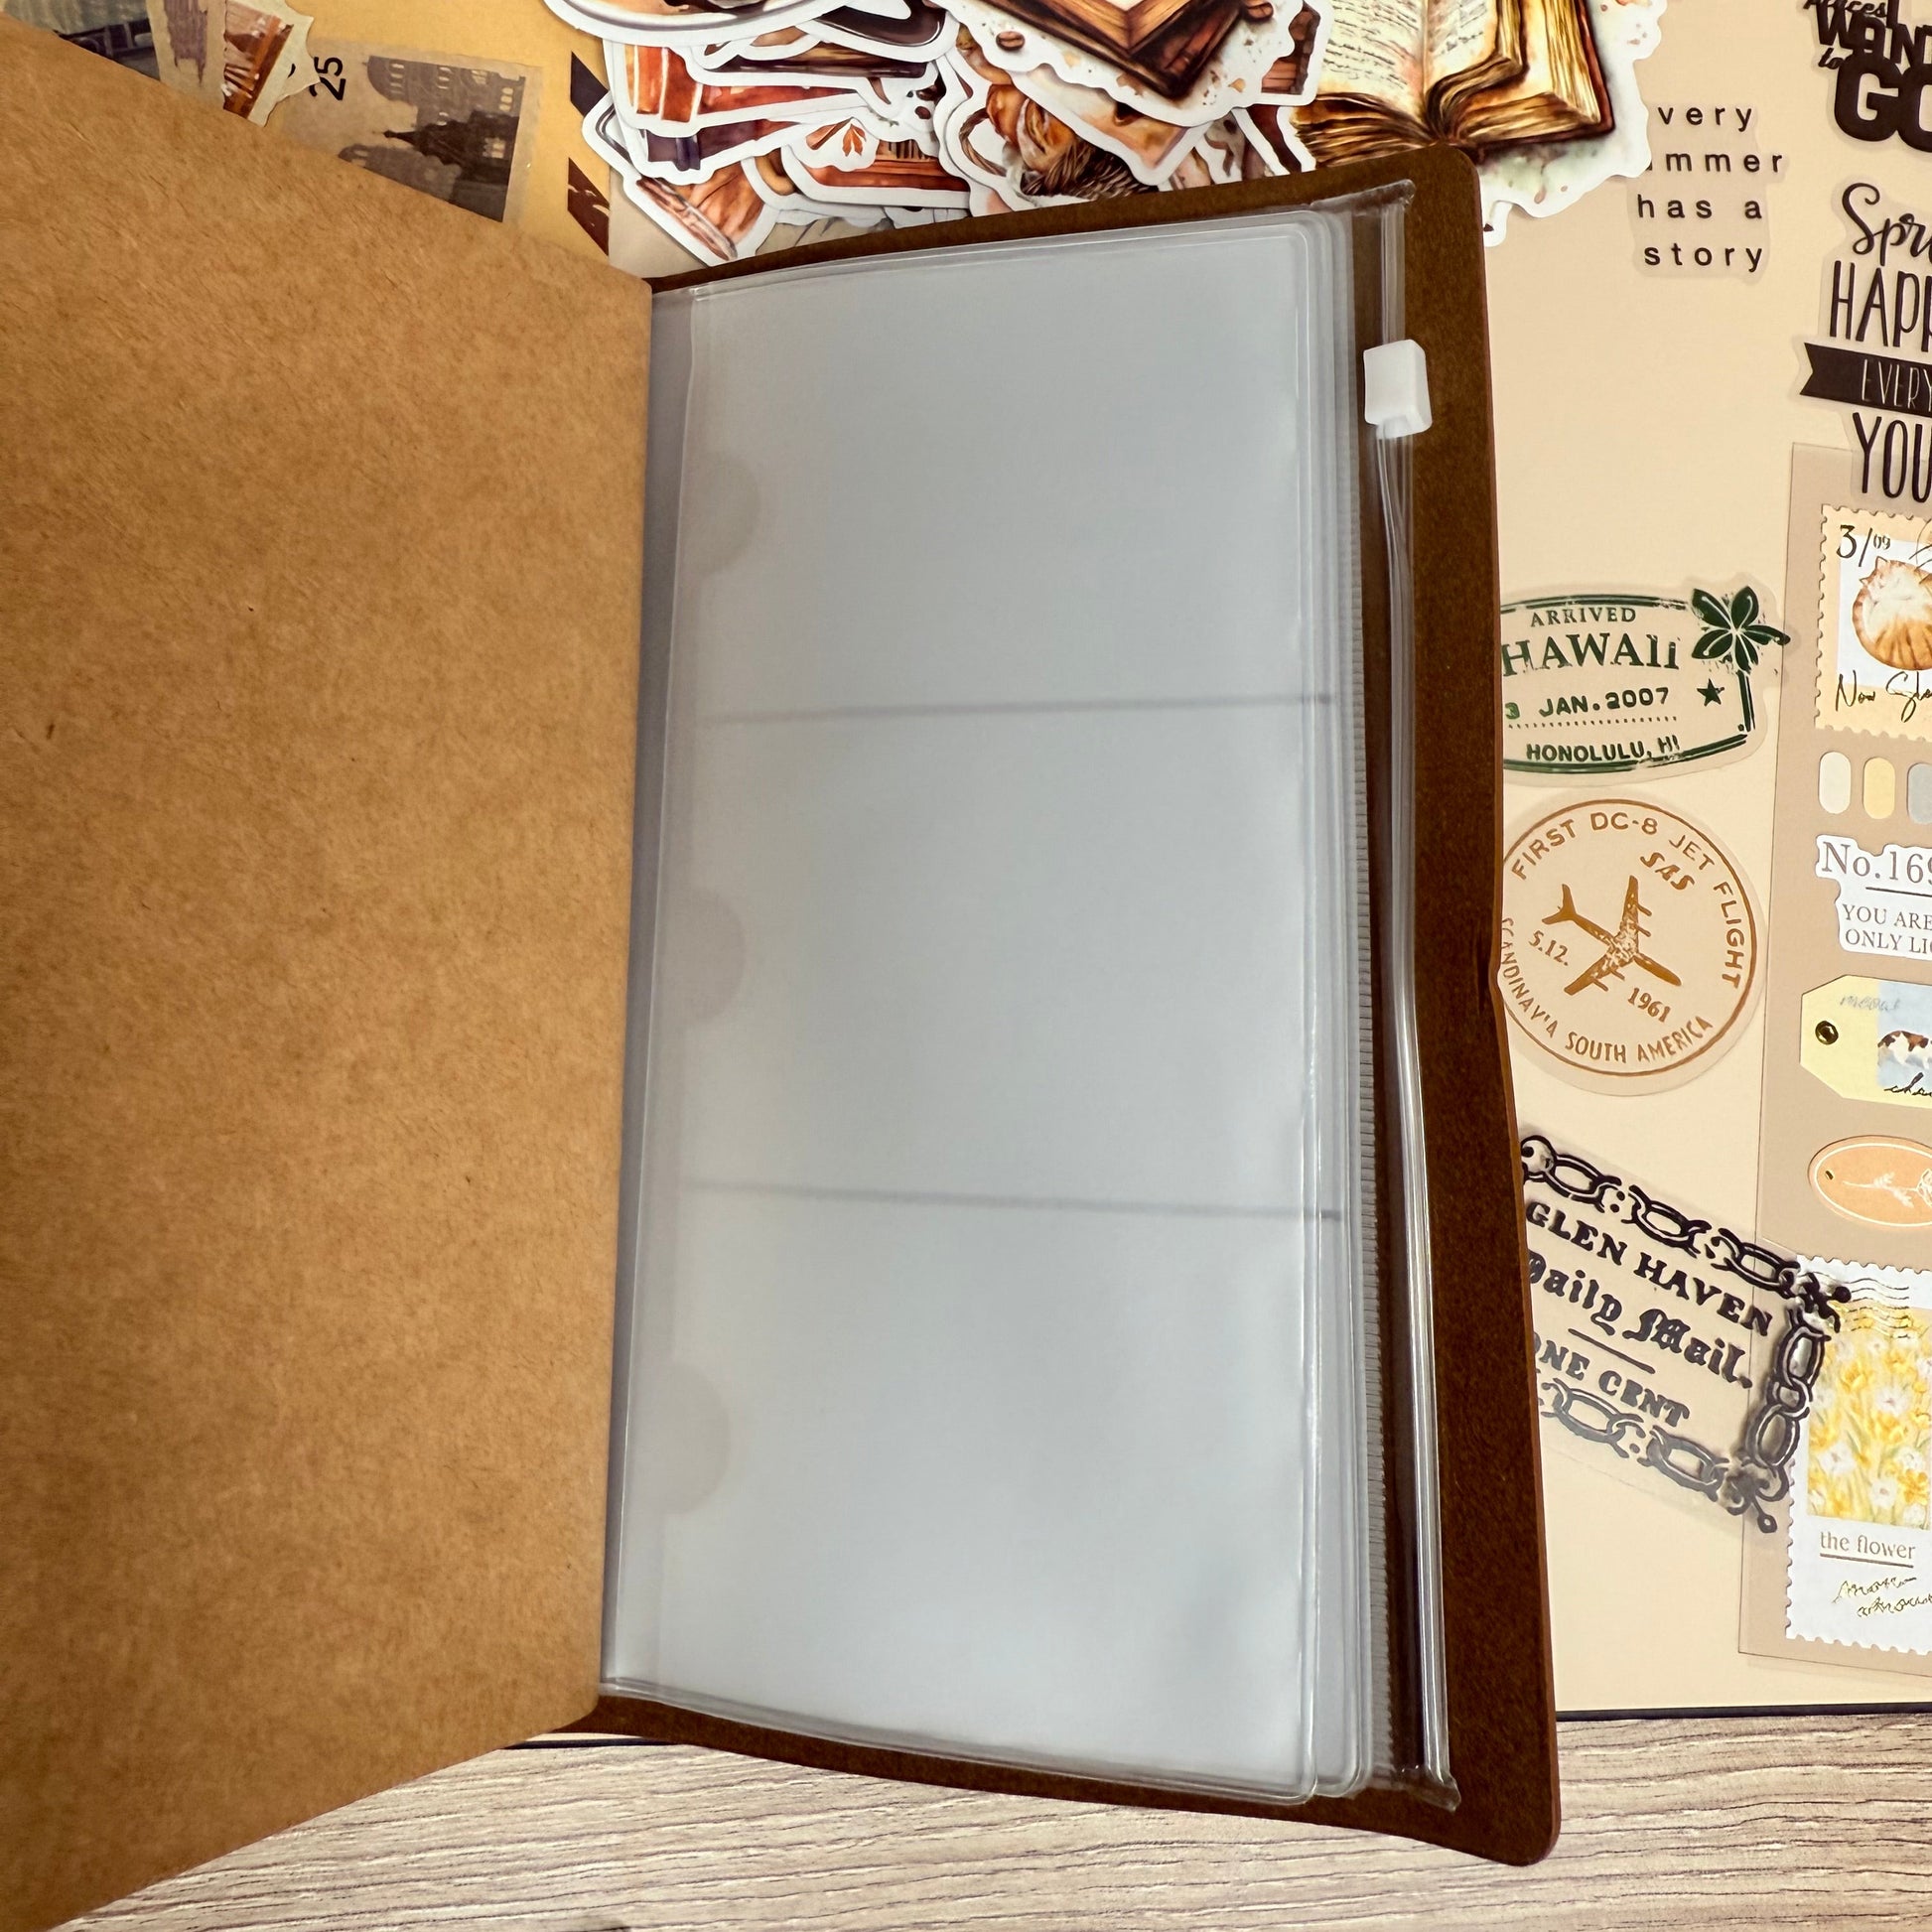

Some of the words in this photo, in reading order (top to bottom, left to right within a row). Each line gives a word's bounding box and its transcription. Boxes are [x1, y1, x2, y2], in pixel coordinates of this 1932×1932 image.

[1645, 152, 1783, 173] mmer
[1637, 193, 1714, 219] has
[1744, 200, 1763, 219] a
[1842, 182, 1932, 267] Spr
[1644, 242, 1763, 273] story
[1852, 411, 1932, 503] YOU
[1530, 607, 1637, 627] ARRIVED
[1526, 740, 1653, 762] HONOLULU,
[1656, 734, 1681, 755] HI
[1639, 851, 1696, 891] SAS
[1821, 840, 1932, 886] No.16
[1511, 818, 1577, 881] FIRST
[1589, 811, 1659, 836] DC-8
[1668, 834, 1716, 871] JET
[1713, 881, 1745, 990] FLIGHT
[1842, 902, 1888, 925] YOU
[1892, 910, 1932, 931] ARE
[1845, 928, 1903, 951] ONLY
[1908, 936, 1932, 955] LI
[1626, 987, 1672, 1024] 1961
[1564, 1031, 1628, 1064] SOUTH
[1637, 1015, 1715, 1062] AMERICA
[1525, 1201, 1629, 1267] GLEN
[1633, 1251, 1774, 1337] HAVEN
[1597, 1369, 1691, 1429] CENT
[1819, 1531, 1851, 1552] the
[1857, 1534, 1917, 1560] flower
